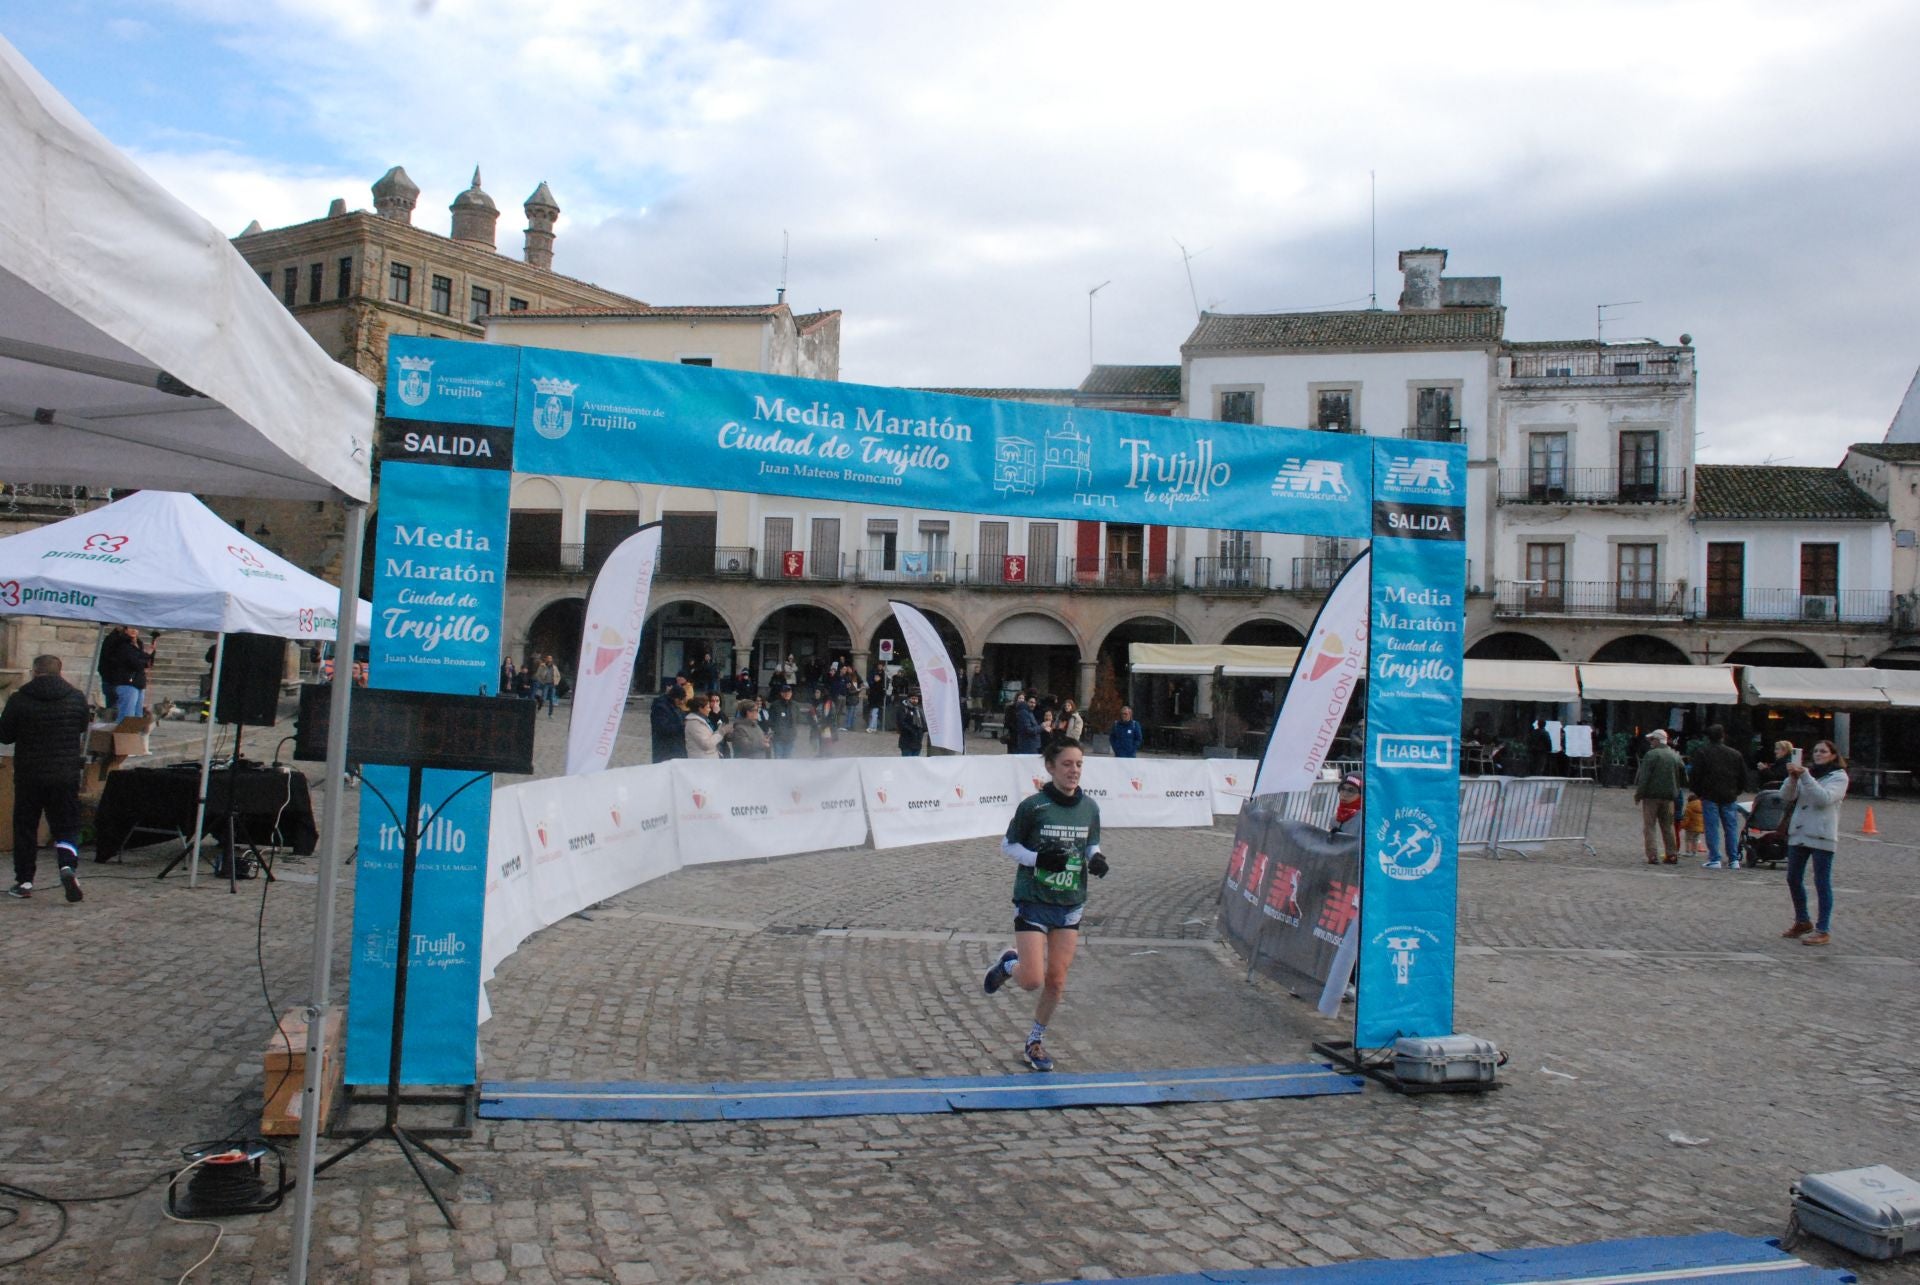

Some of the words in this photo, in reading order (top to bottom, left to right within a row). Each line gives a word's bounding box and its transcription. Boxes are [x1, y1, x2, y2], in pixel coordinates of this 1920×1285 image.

[437, 384, 482, 400] Trujillo
[495, 379, 506, 387] de
[582, 400, 651, 416] Ayuntamiento
[652, 408, 665, 418] de
[752, 395, 846, 430] Media
[854, 406, 973, 442] Maratón
[580, 413, 637, 432] Trujillo
[404, 431, 492, 458] SALIDA
[718, 421, 815, 456] Ciudad
[818, 435, 852, 459] de
[858, 436, 950, 475] Trujillo
[758, 460, 789, 475] Juan
[793, 463, 840, 480] Mateos
[843, 468, 903, 486] Broncano
[1120, 437, 1231, 497] Trujillo
[1144, 485, 1157, 502] te
[1271, 489, 1348, 502] www.musicrun.es
[1383, 484, 1452, 496] www.musicrun.es
[1388, 511, 1451, 531] SALIDA
[393, 525, 490, 551] Media
[41, 549, 130, 565] primaflor
[384, 557, 495, 583] Maratón
[22, 587, 98, 608] primaflor
[398, 588, 456, 607] Ciudad
[457, 593, 480, 608] de
[1384, 585, 1451, 606] Media
[382, 607, 490, 651] Trujillo
[1379, 613, 1457, 632] Maratón
[626, 637, 638, 658] DE
[1387, 636, 1427, 652] Ciudad
[1429, 641, 1444, 653] de
[384, 653, 406, 663] Juan
[408, 655, 441, 664] Mateos
[444, 657, 486, 667] Broncano
[1377, 653, 1454, 688] Trujillo
[1304, 674, 1353, 774] DIPUTACIÓN
[1345, 648, 1361, 669] DE
[1386, 744, 1441, 759] HABLA
[1395, 806, 1437, 830] Atletismo
[1045, 871, 1073, 887] 208
[411, 932, 466, 956] Trujillo
